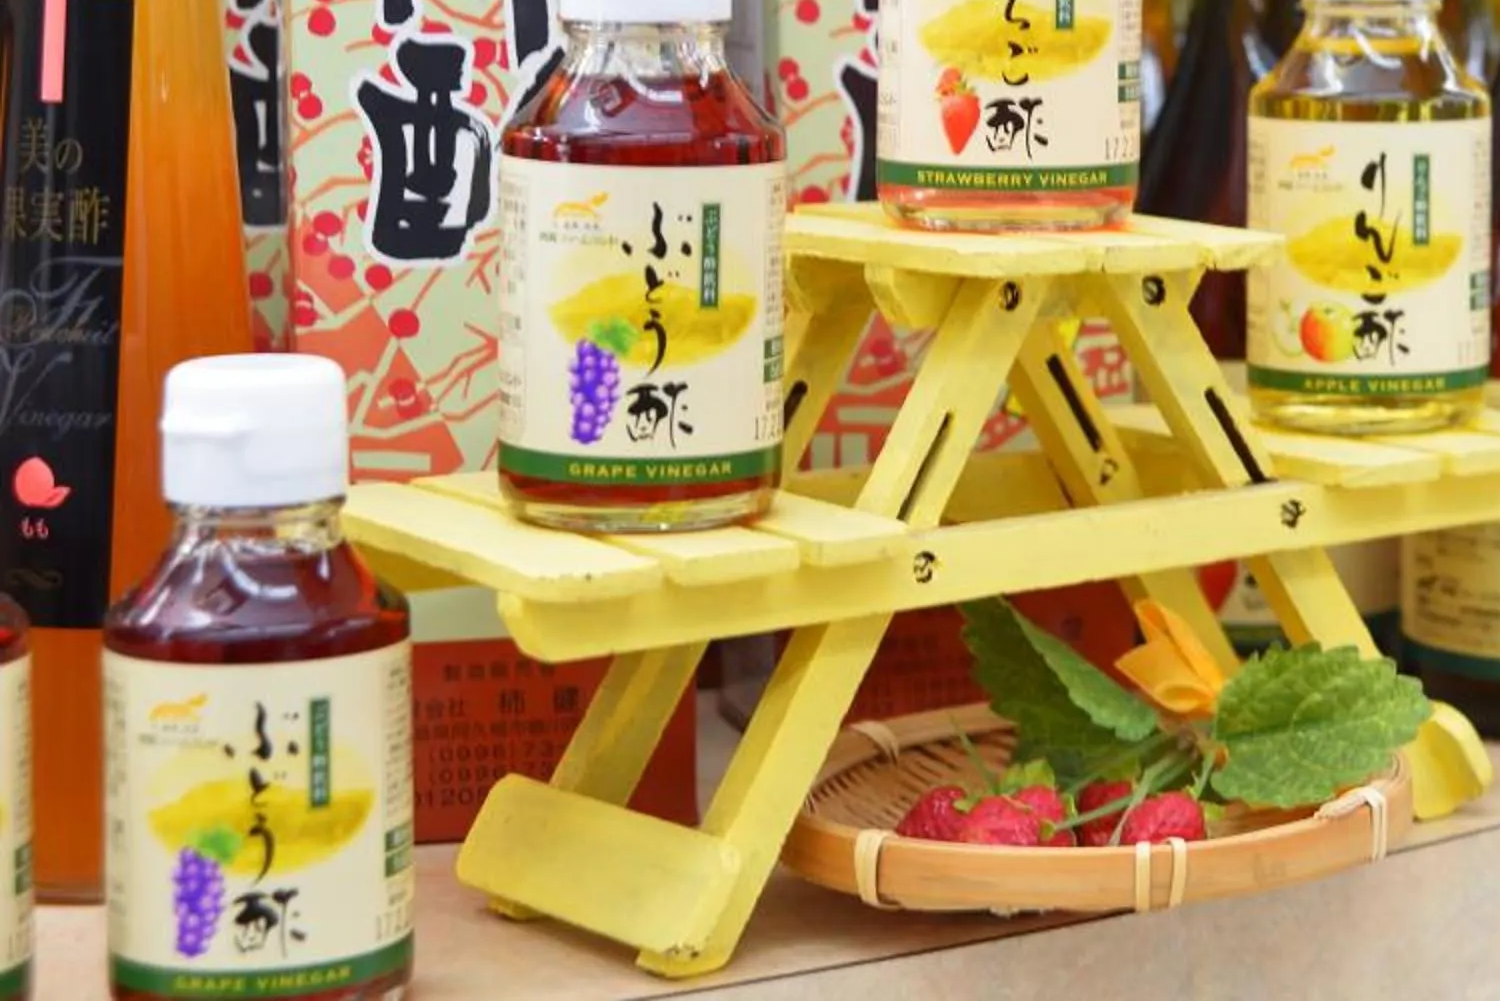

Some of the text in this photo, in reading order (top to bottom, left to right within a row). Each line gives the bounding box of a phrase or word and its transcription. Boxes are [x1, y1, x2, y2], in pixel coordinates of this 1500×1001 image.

[917, 167, 1108, 186] STRAWBERRY VINEGAR
[1352, 151, 1410, 367] りんご酢
[621, 201, 694, 449] ぶどう酢
[1304, 377, 1446, 392] APPLE VINEGAR
[569, 461, 733, 479] GRAPE VINEGAR
[224, 701, 307, 959] ぶどう酢
[174, 964, 351, 992] GRAPE VINEGAR
